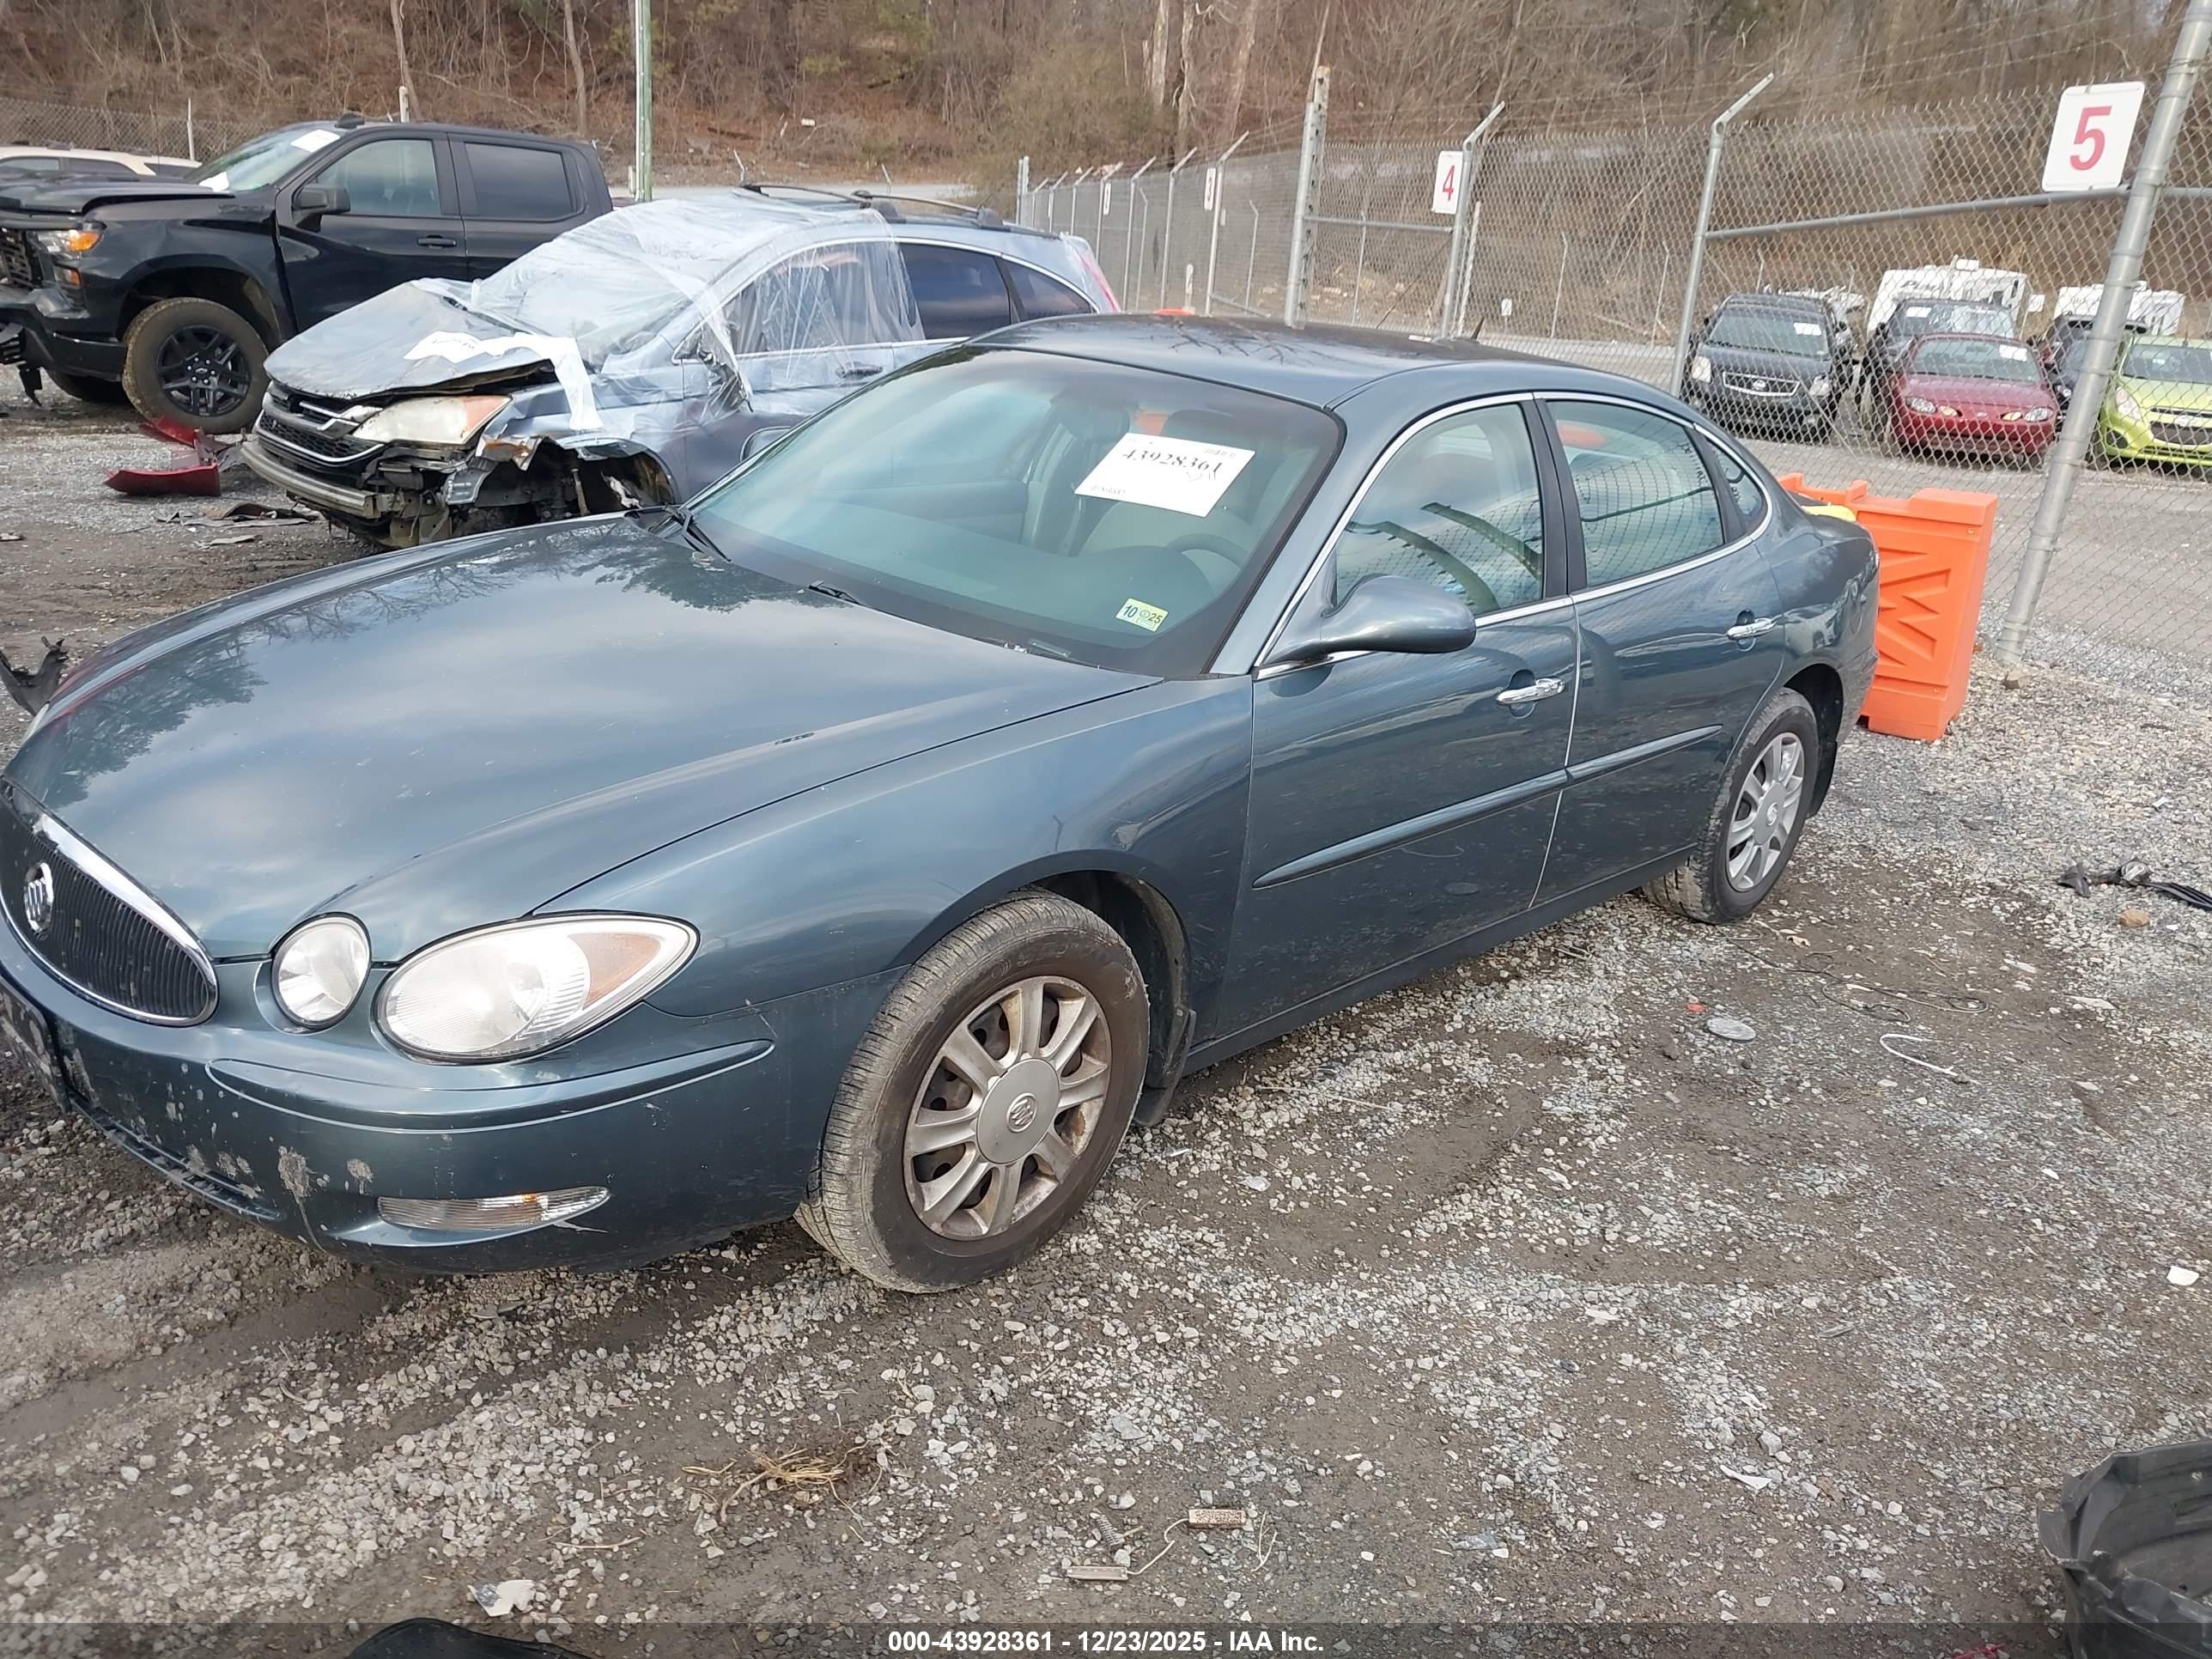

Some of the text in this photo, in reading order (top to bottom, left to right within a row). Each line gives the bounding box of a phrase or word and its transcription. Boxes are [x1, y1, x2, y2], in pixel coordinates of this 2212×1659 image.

[2069, 106, 2112, 171] 5
[1443, 165, 1455, 201] 4
[1122, 449, 1223, 474] 43928361
[1123, 605, 1163, 624] 10 25
